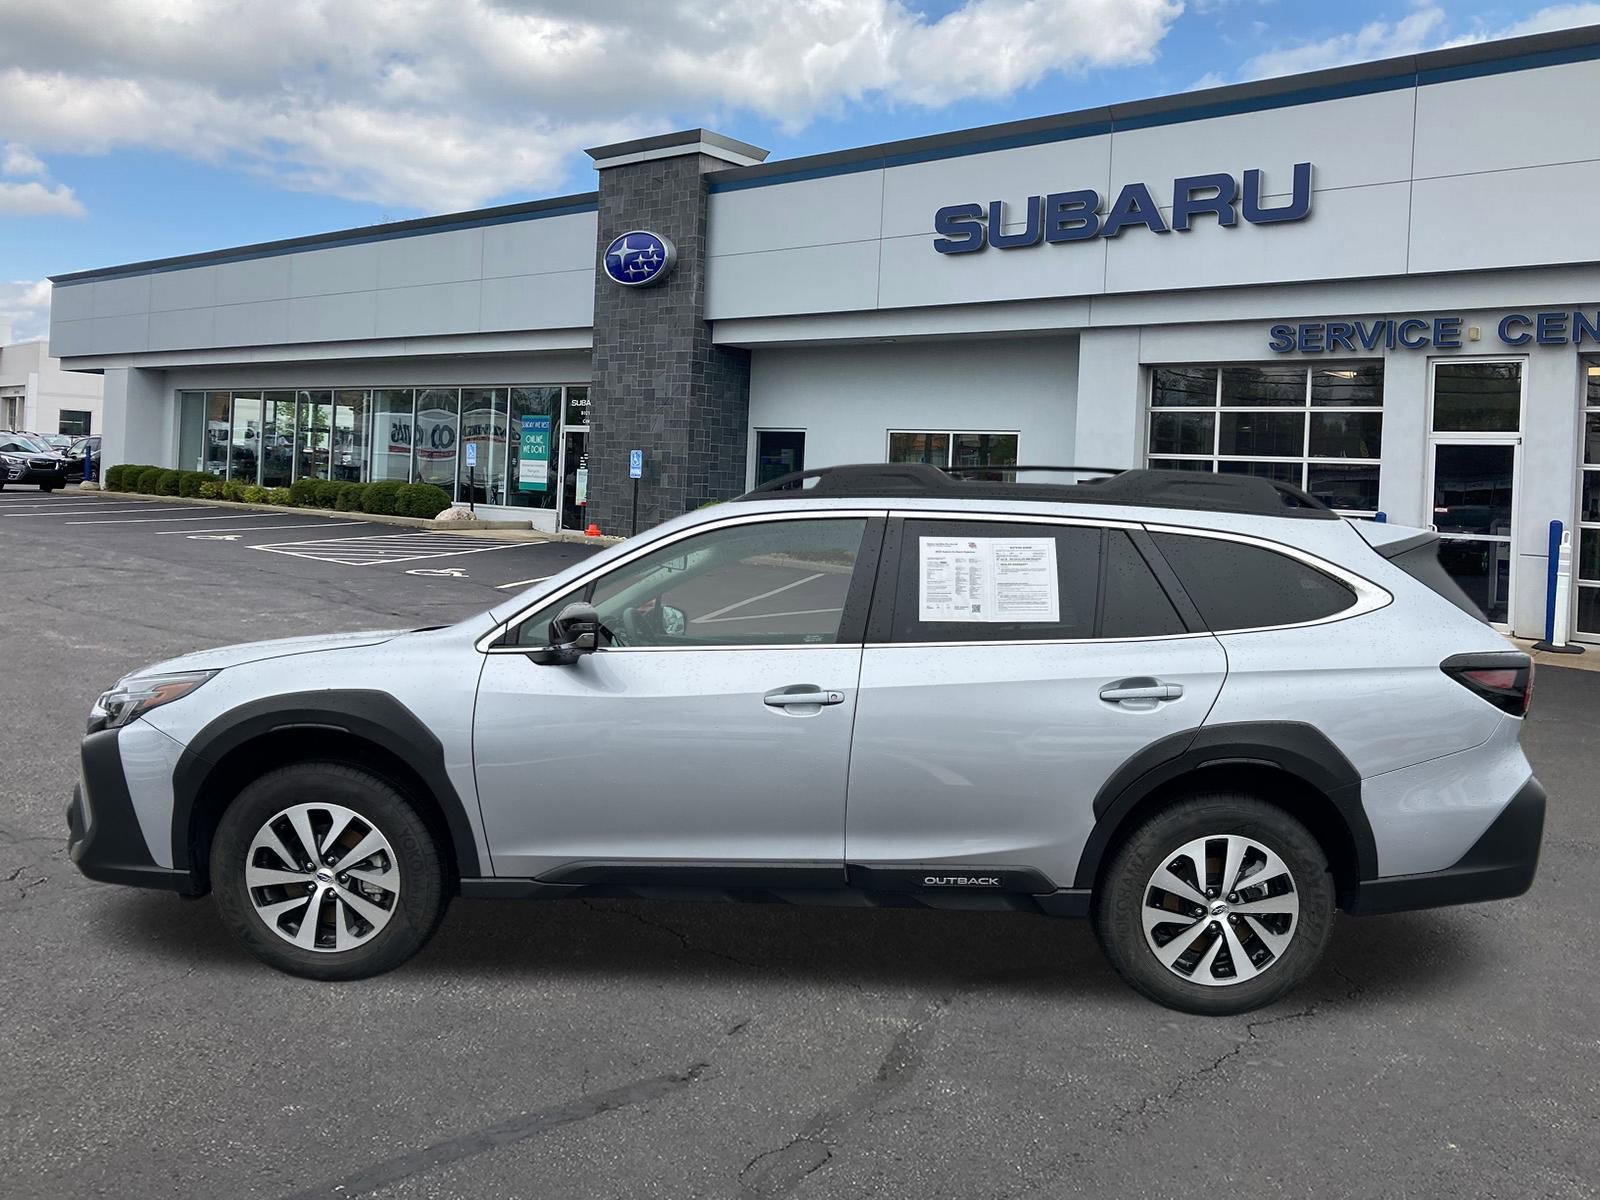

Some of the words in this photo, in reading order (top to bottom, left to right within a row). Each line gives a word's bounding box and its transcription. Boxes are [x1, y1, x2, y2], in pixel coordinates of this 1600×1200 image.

[933, 161, 1313, 256] SUBARU
[1268, 317, 1464, 353] SERVICE
[924, 876, 999, 885] OUTBACK
